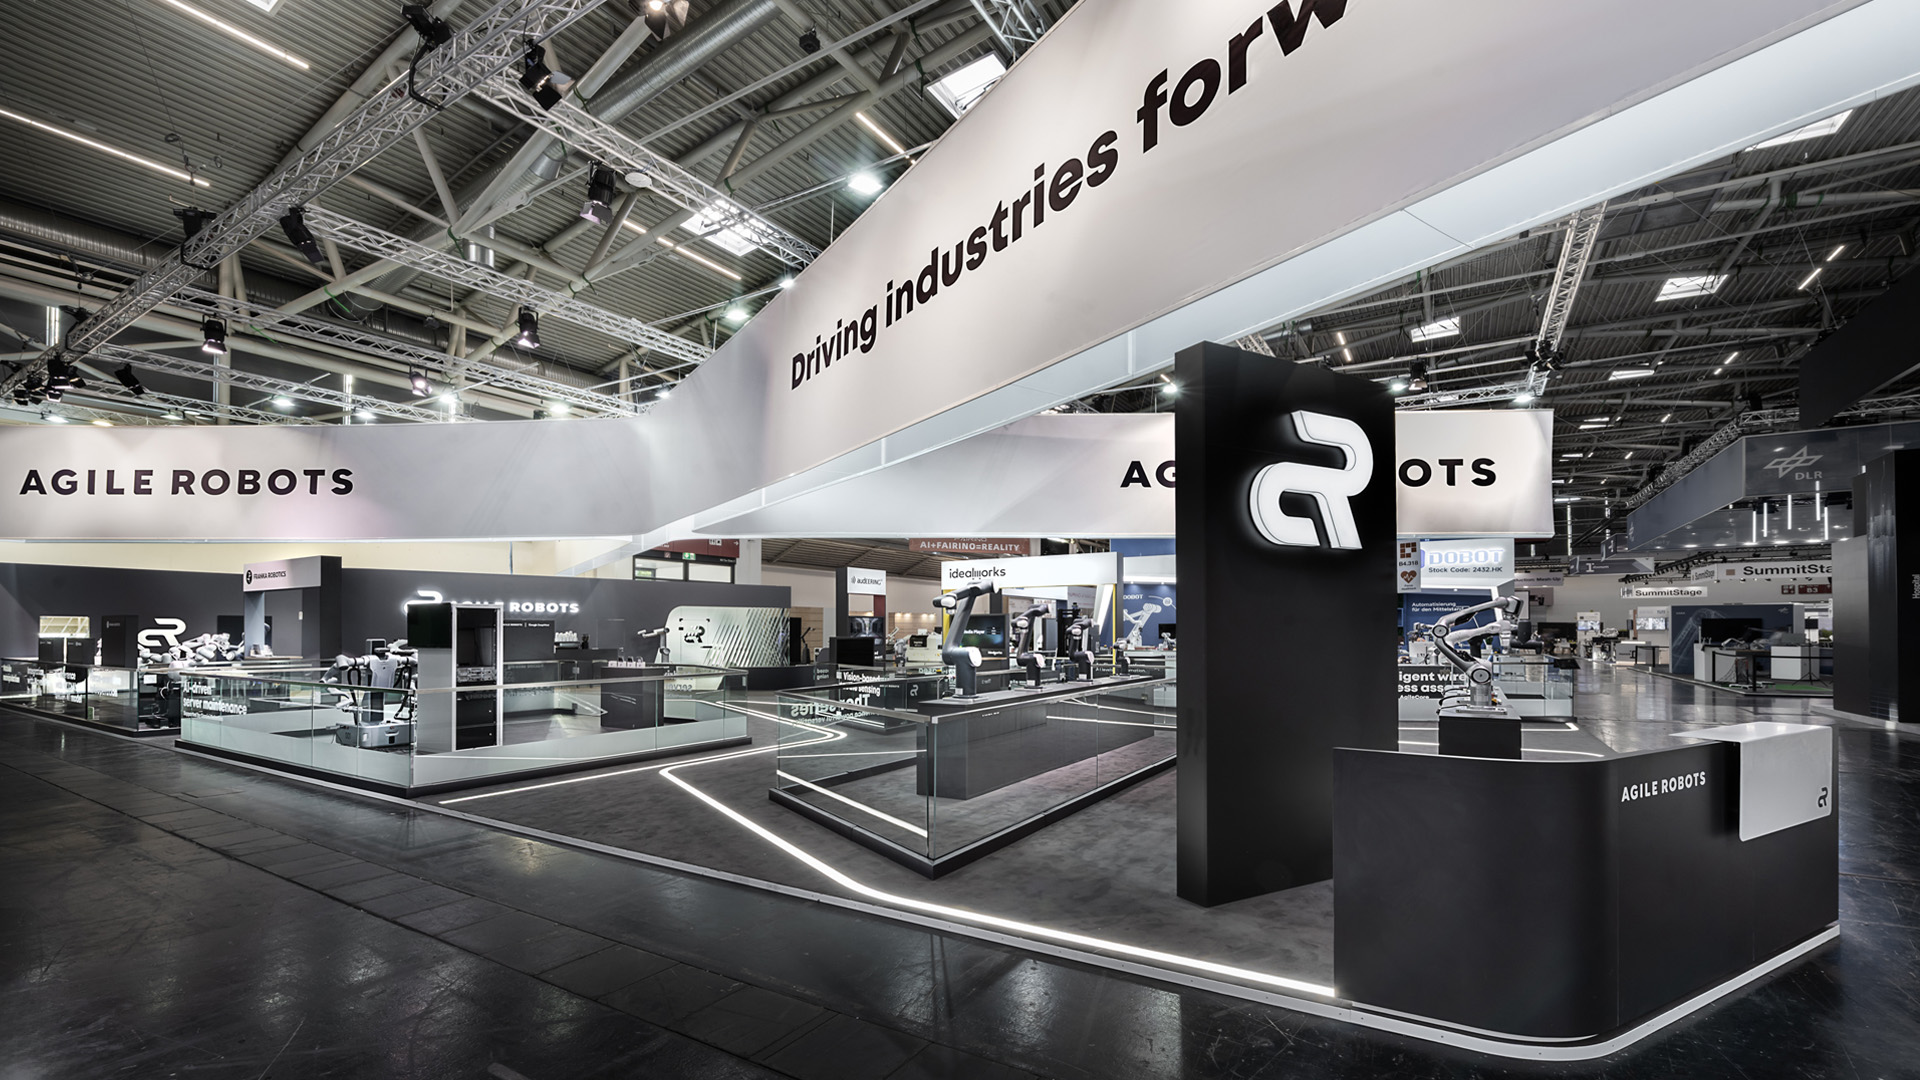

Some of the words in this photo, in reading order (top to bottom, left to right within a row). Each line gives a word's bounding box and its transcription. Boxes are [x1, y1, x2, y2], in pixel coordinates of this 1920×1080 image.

[792, 304, 877, 389] Driving
[885, 130, 1118, 328] industries
[1120, 461, 1176, 488] AG
[1399, 458, 1497, 487] OTS
[1795, 471, 1822, 480] DLR
[19, 469, 153, 496] AGILE
[171, 469, 354, 496] ROBOTS
[920, 541, 1020, 551] AI+FAIRINO=REALITY
[1429, 549, 1505, 565] DOBOT
[1743, 564, 1832, 575] SummitSta
[1635, 588, 1702, 597] SummitStage
[509, 602, 579, 613] ROBOTS
[1398, 671, 1435, 683] igent
[1398, 684, 1418, 693] ess
[1420, 684, 1444, 693] ass
[183, 697, 202, 708] server
[202, 698, 248, 715] maintenance
[1621, 781, 1658, 802] AGILE
[1661, 771, 1706, 794] ROBOTS
